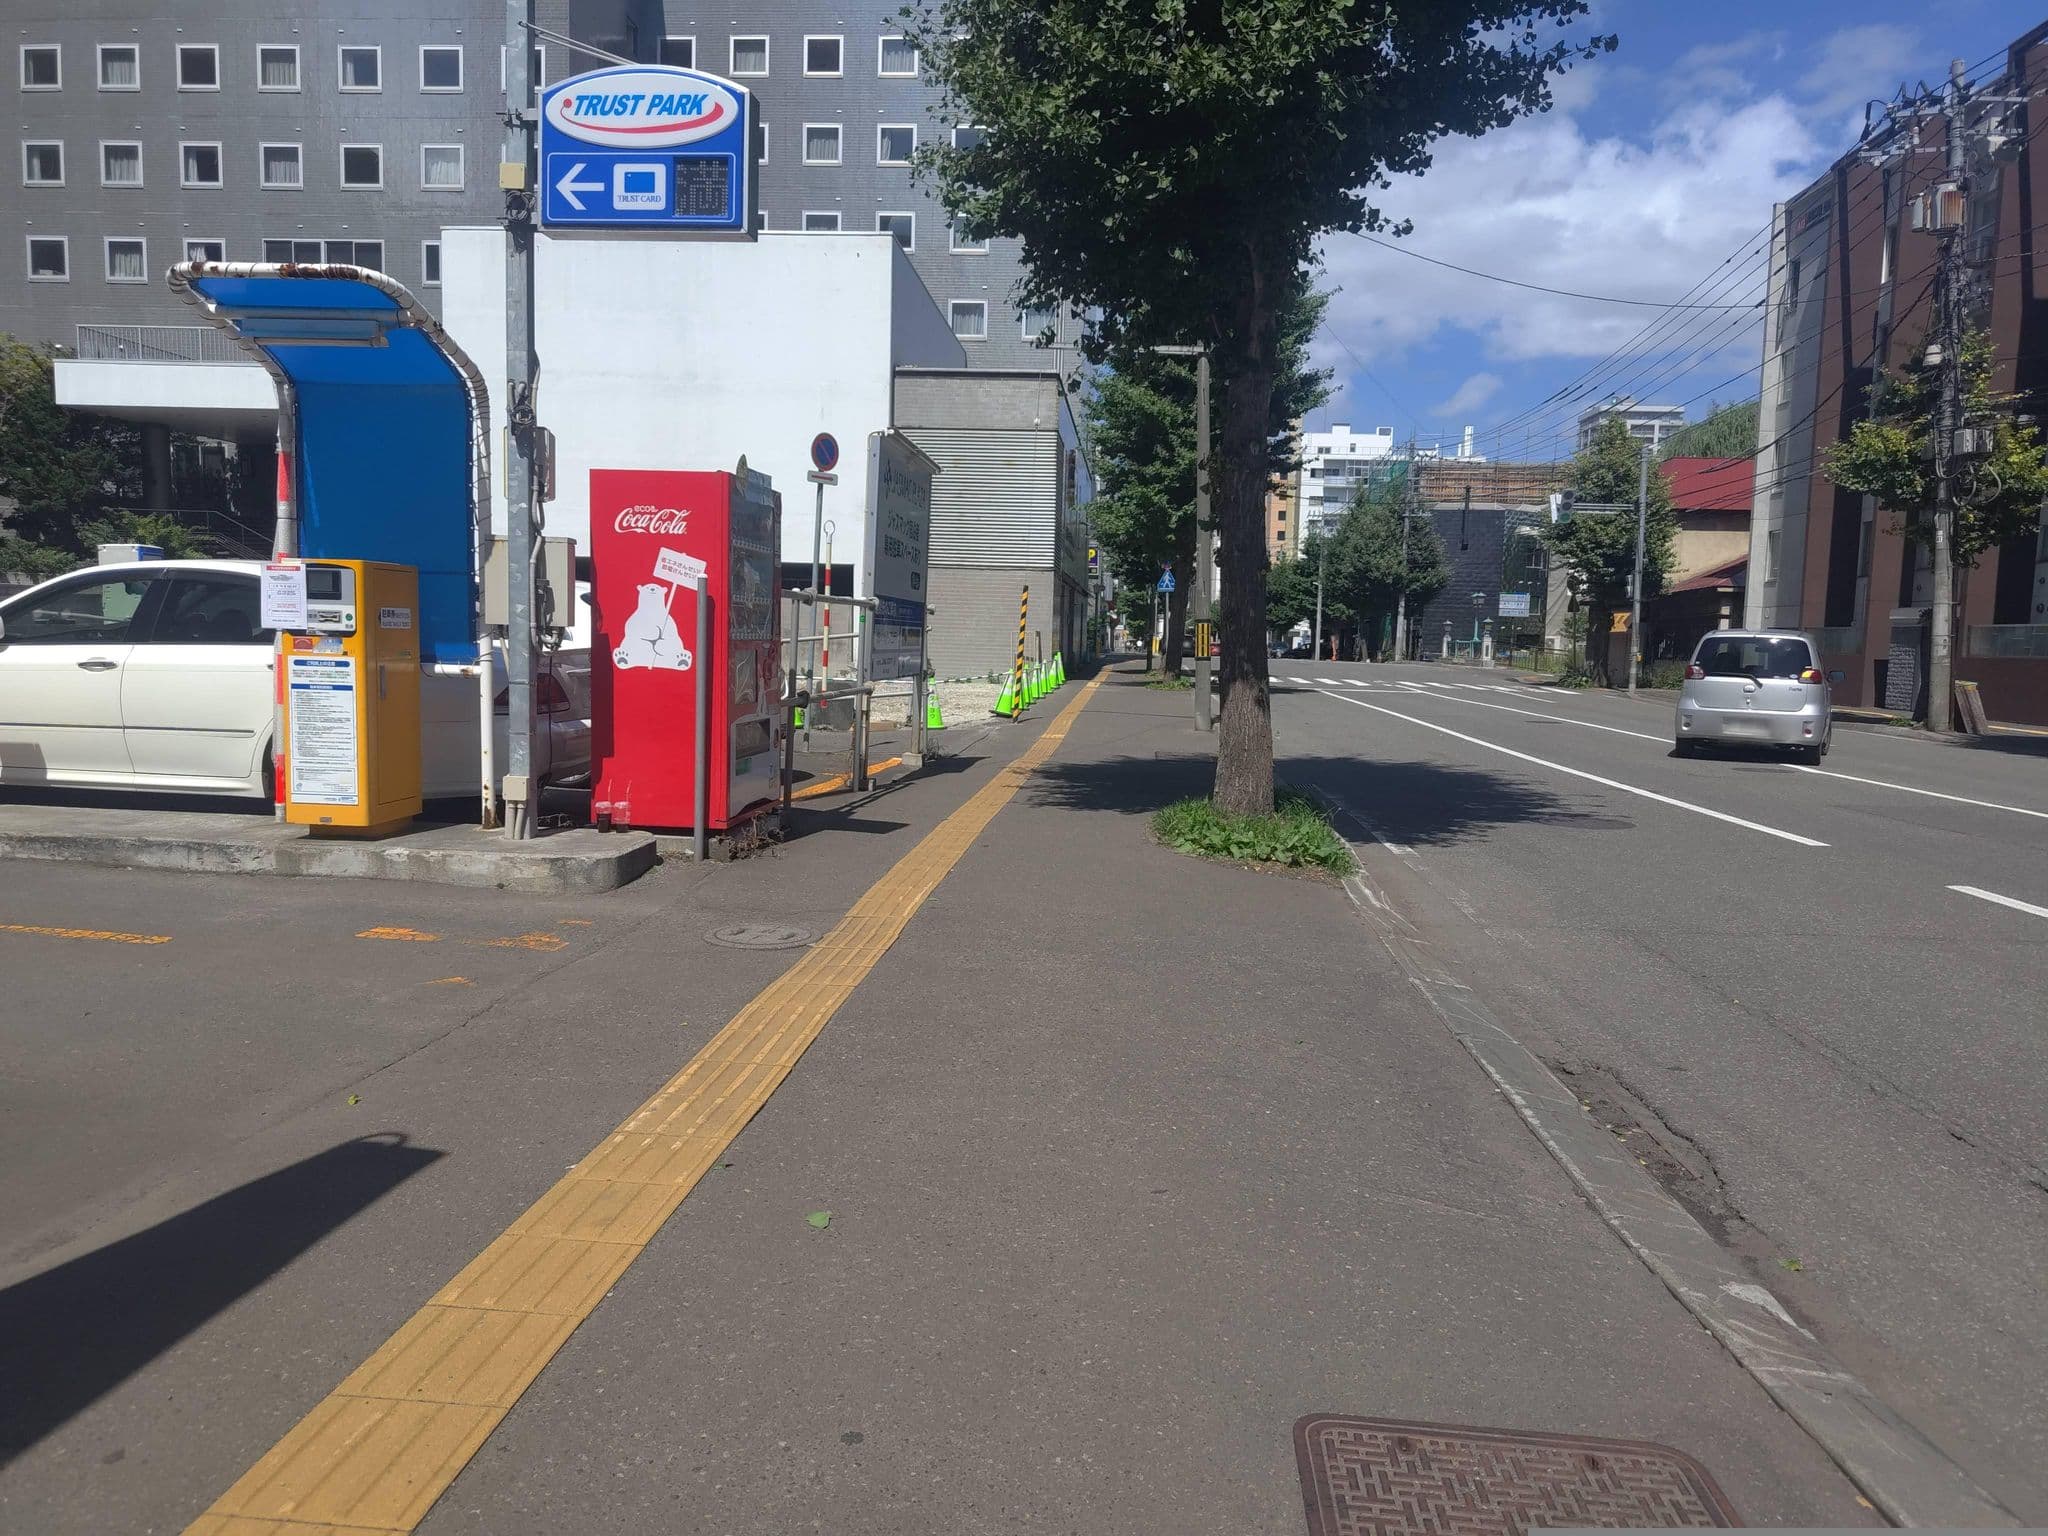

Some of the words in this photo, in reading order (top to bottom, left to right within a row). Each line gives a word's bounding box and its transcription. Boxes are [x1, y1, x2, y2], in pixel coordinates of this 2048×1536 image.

[573, 94, 646, 116] TRUST
[646, 94, 709, 116] PARK
[617, 194, 639, 203] TRUST
[640, 194, 662, 203] CARD
[613, 507, 692, 534] Coca-Cola
